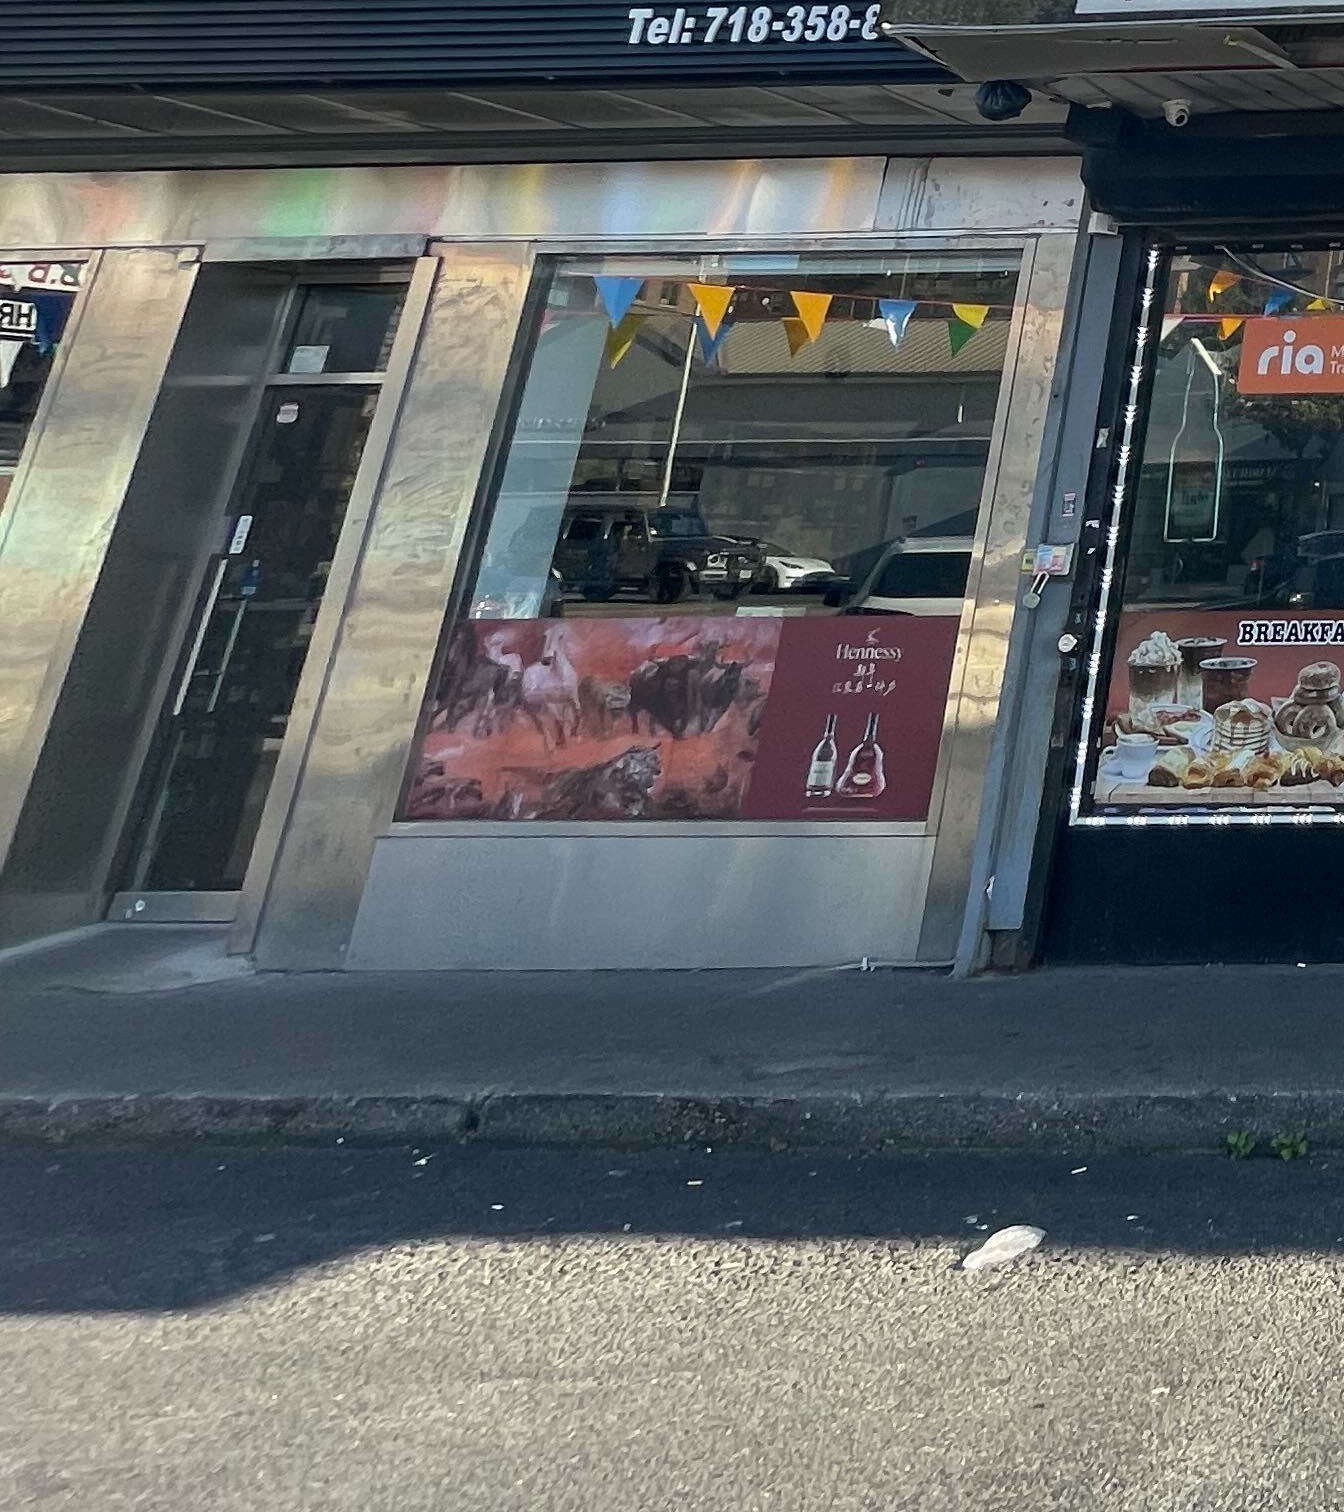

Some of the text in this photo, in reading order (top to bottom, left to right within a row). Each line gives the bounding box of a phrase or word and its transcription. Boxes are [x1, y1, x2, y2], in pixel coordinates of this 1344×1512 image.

[628, 8, 696, 44] Tel:
[1257, 330, 1324, 375] ria
[836, 644, 902, 661] Hennessy
